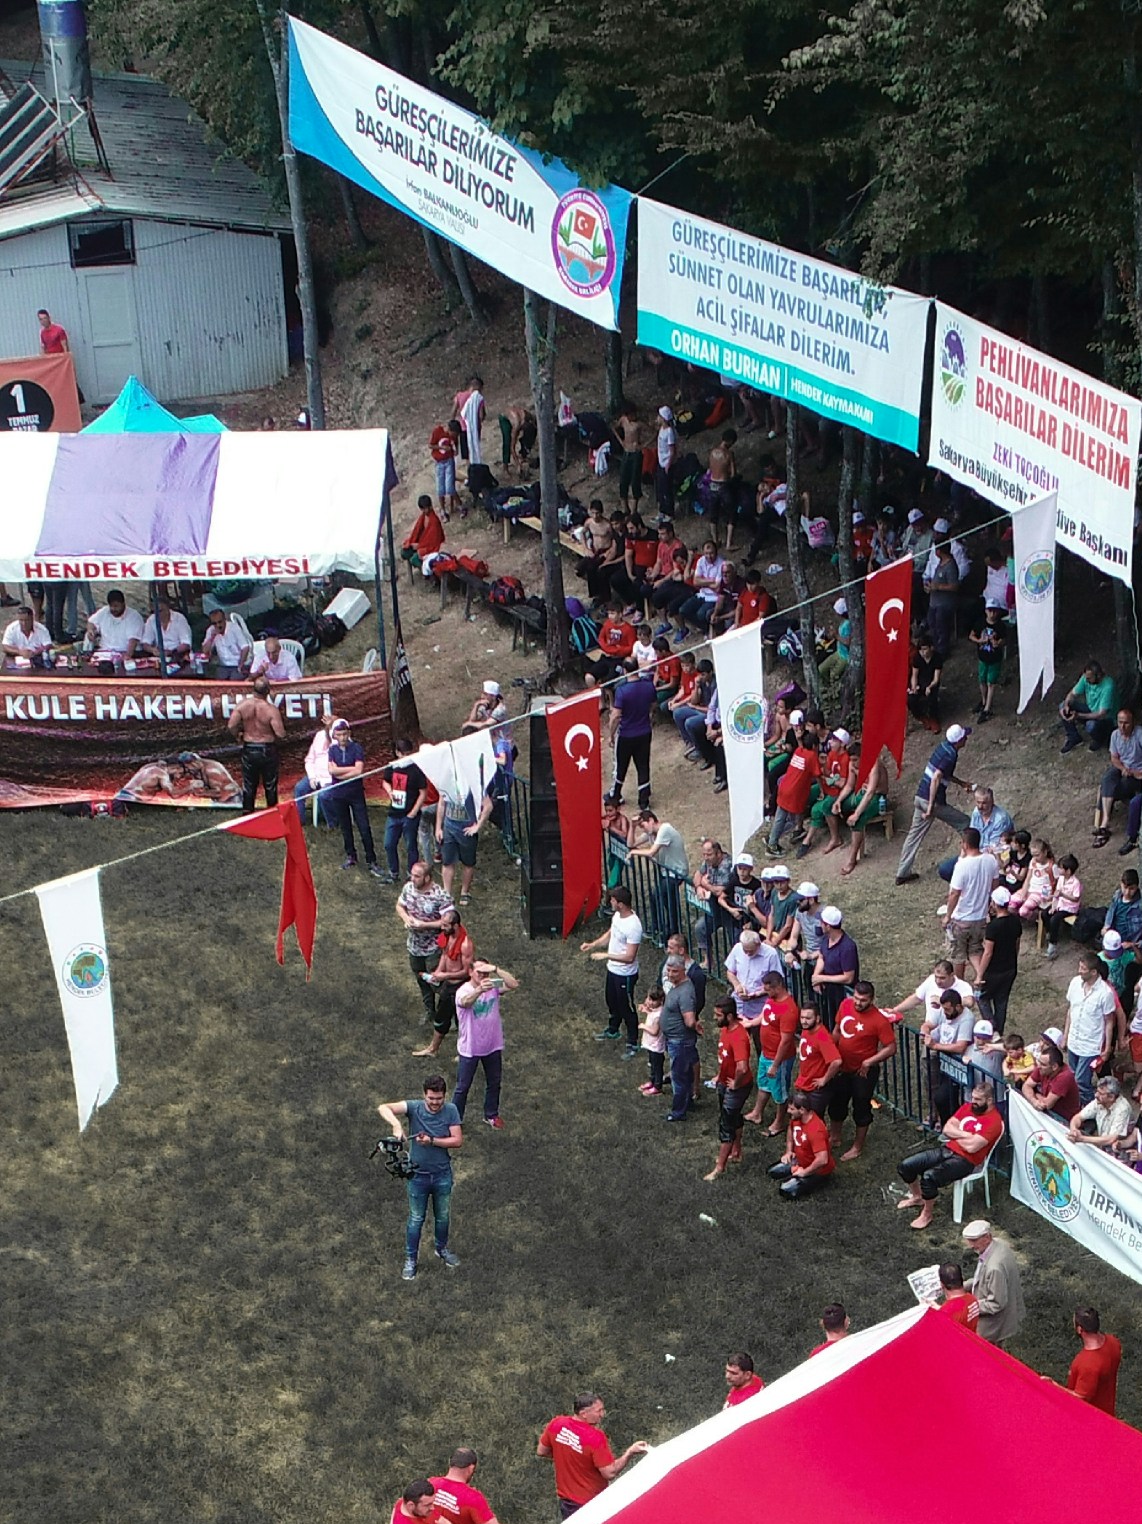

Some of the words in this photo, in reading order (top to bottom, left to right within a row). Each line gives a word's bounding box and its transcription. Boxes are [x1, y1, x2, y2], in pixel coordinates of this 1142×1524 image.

[375, 84, 517, 182] GÜREŞÇİLERİMİZE
[355, 108, 437, 177] BAŞARILAR
[443, 156, 535, 234] DİLİYORUM
[672, 218, 797, 283] GÜREŞÇİLERİMİZE
[668, 249, 723, 291] SÜNNET
[728, 273, 766, 305] OLAN
[770, 287, 890, 354] YAVRULARIMIZA
[696, 296, 727, 327] ACİL
[730, 304, 786, 348] ŞİFALAR
[791, 328, 856, 376] DİLERİM.
[10, 384, 26, 413] 1
[671, 329, 720, 367] ORHAN
[722, 347, 781, 390] BURHAN
[790, 376, 823, 403] HENDEK
[980, 336, 1129, 445] PEHLİVANLARIMIZA
[7, 414, 40, 428] TEMMUZ
[975, 375, 1057, 449] BAŞARILAR
[1061, 421, 1131, 491] DİLERİM
[992, 441, 1013, 469] ZEKİ
[939, 438, 975, 474] Sakarya
[1078, 520, 1128, 567] Başkanı
[24, 562, 139, 580] HENDEK
[153, 554, 311, 578] BELEDİYESİ
[5, 694, 88, 721] KULE
[95, 694, 214, 721] HAKEM
[222, 692, 332, 720] HYETİ
[1087, 1209, 1127, 1242] Hendek
[1088, 1184, 1135, 1229] İRFAN
